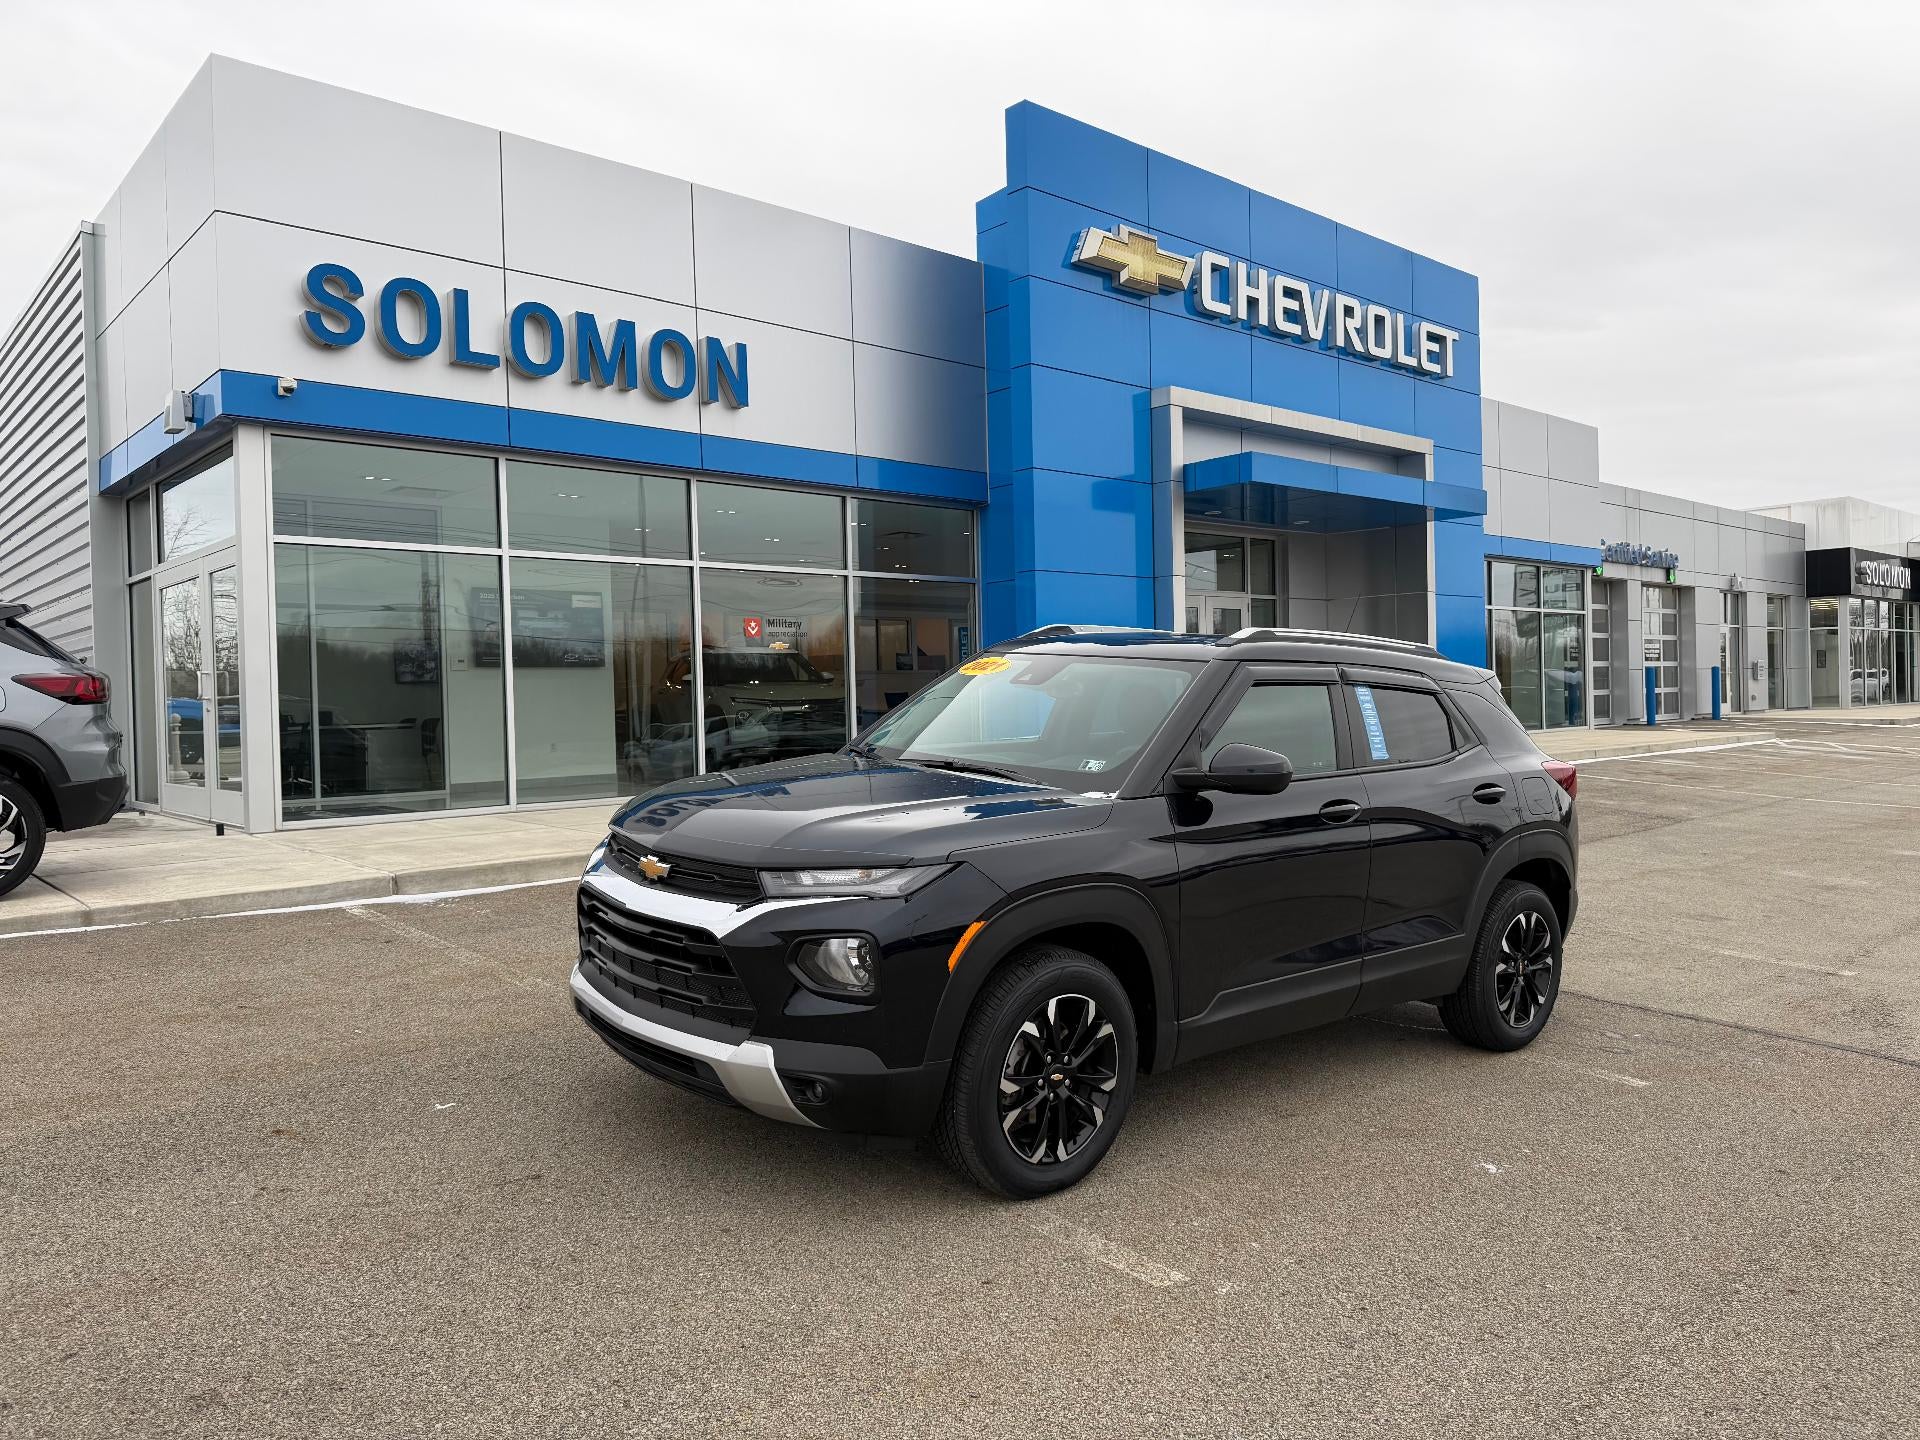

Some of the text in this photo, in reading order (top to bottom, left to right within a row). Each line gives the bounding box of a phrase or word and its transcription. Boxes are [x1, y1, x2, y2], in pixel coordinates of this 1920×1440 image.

[1196, 250, 1460, 378] CHEVROLET
[299, 262, 749, 410] SOLOMON
[1643, 545, 1679, 569] Service
[1865, 560, 1911, 589] SOLOMON
[767, 618, 802, 630] Military
[767, 630, 808, 639] appreciation
